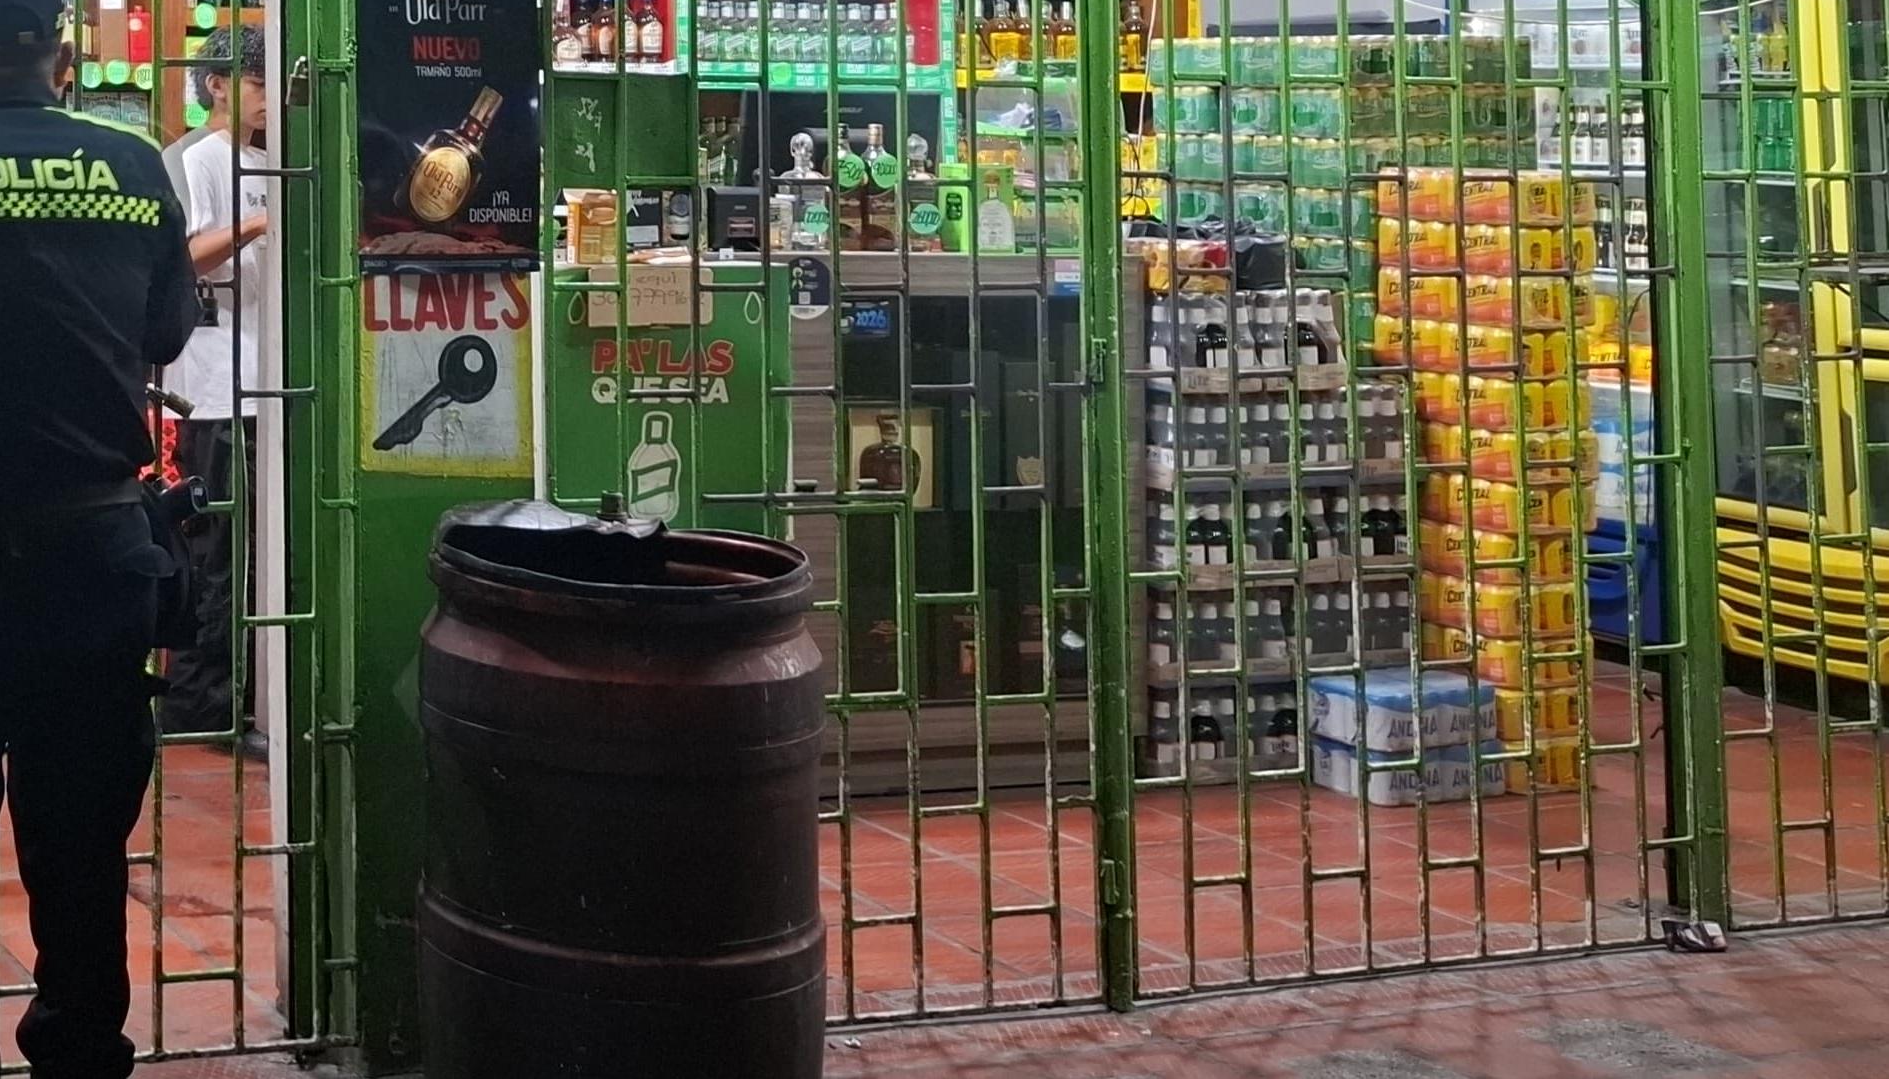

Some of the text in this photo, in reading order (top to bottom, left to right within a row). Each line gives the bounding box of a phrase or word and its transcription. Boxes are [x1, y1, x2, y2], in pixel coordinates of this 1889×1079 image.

[413, 36, 481, 61] NUEVO
[415, 63, 482, 78] TAMAÑO 500ml
[492, 190, 510, 206] ¡YA
[469, 207, 532, 223] DISPONIBLE!
[363, 272, 531, 333] LLAVES
